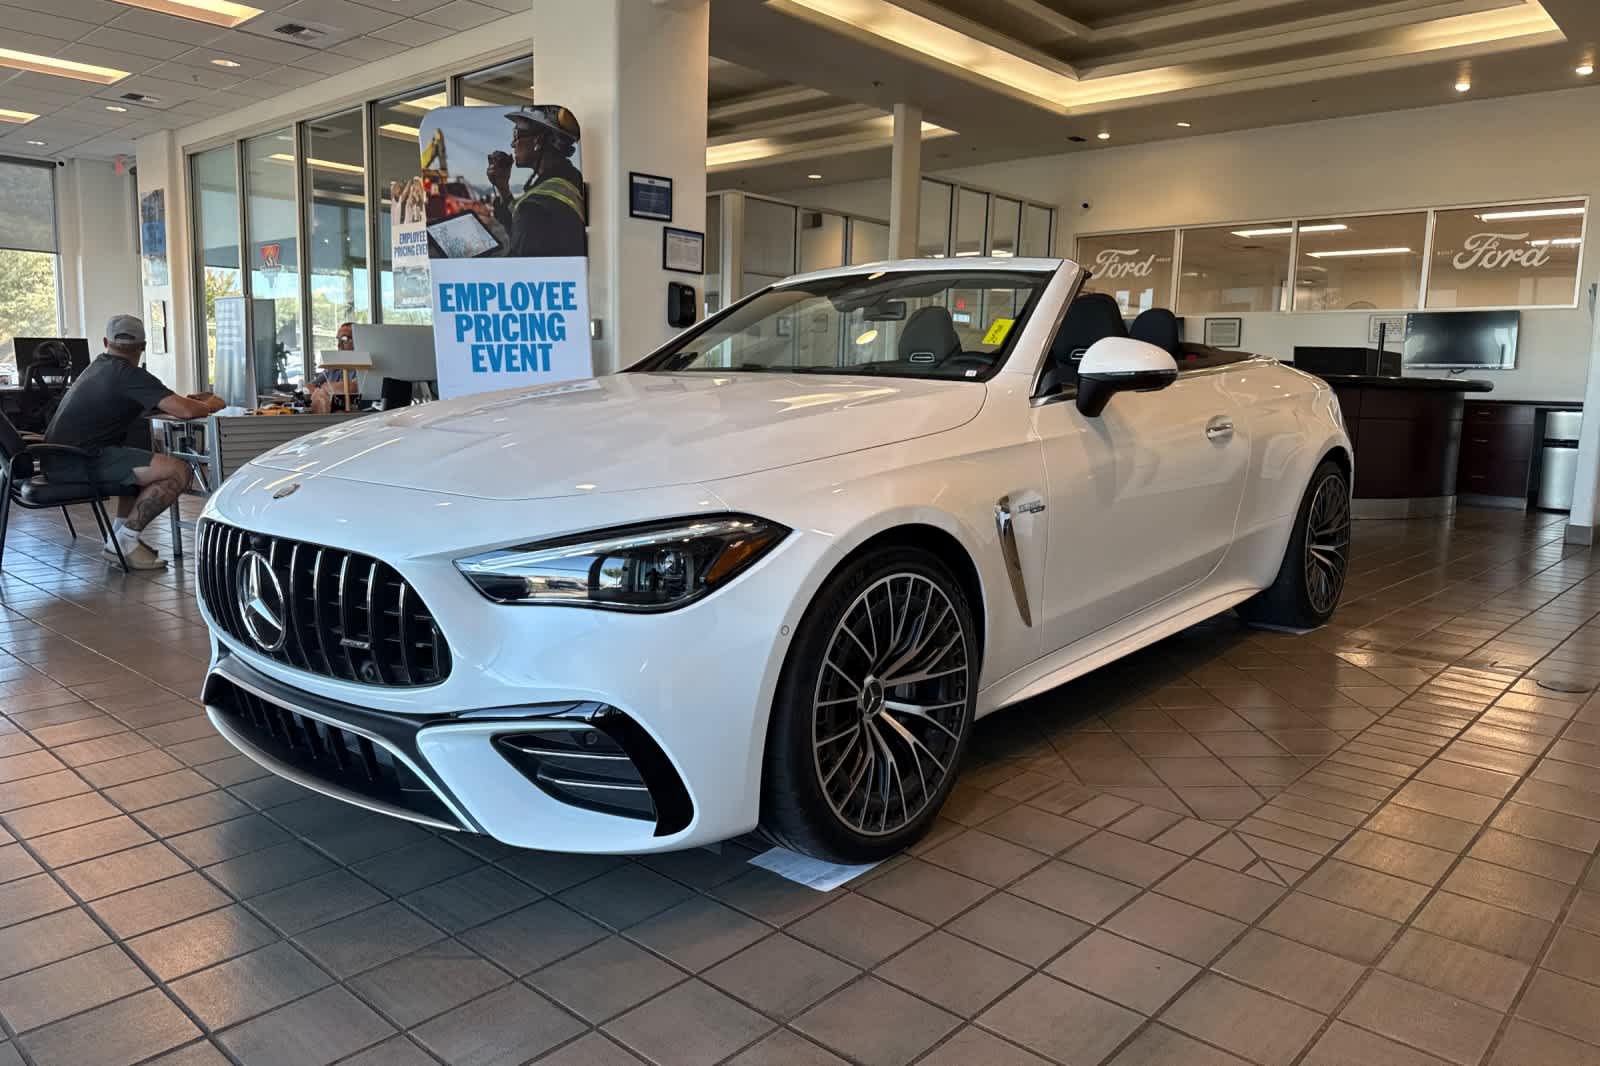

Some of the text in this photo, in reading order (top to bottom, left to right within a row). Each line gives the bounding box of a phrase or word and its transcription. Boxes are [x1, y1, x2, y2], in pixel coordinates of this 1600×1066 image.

[399, 231, 426, 244] EMPLOYEE
[1453, 232, 1551, 270] Ford
[1090, 249, 1156, 280] Ford
[439, 281, 578, 312] EMPLOYEE
[455, 312, 566, 342] PRICING
[471, 343, 552, 372] EVENT
